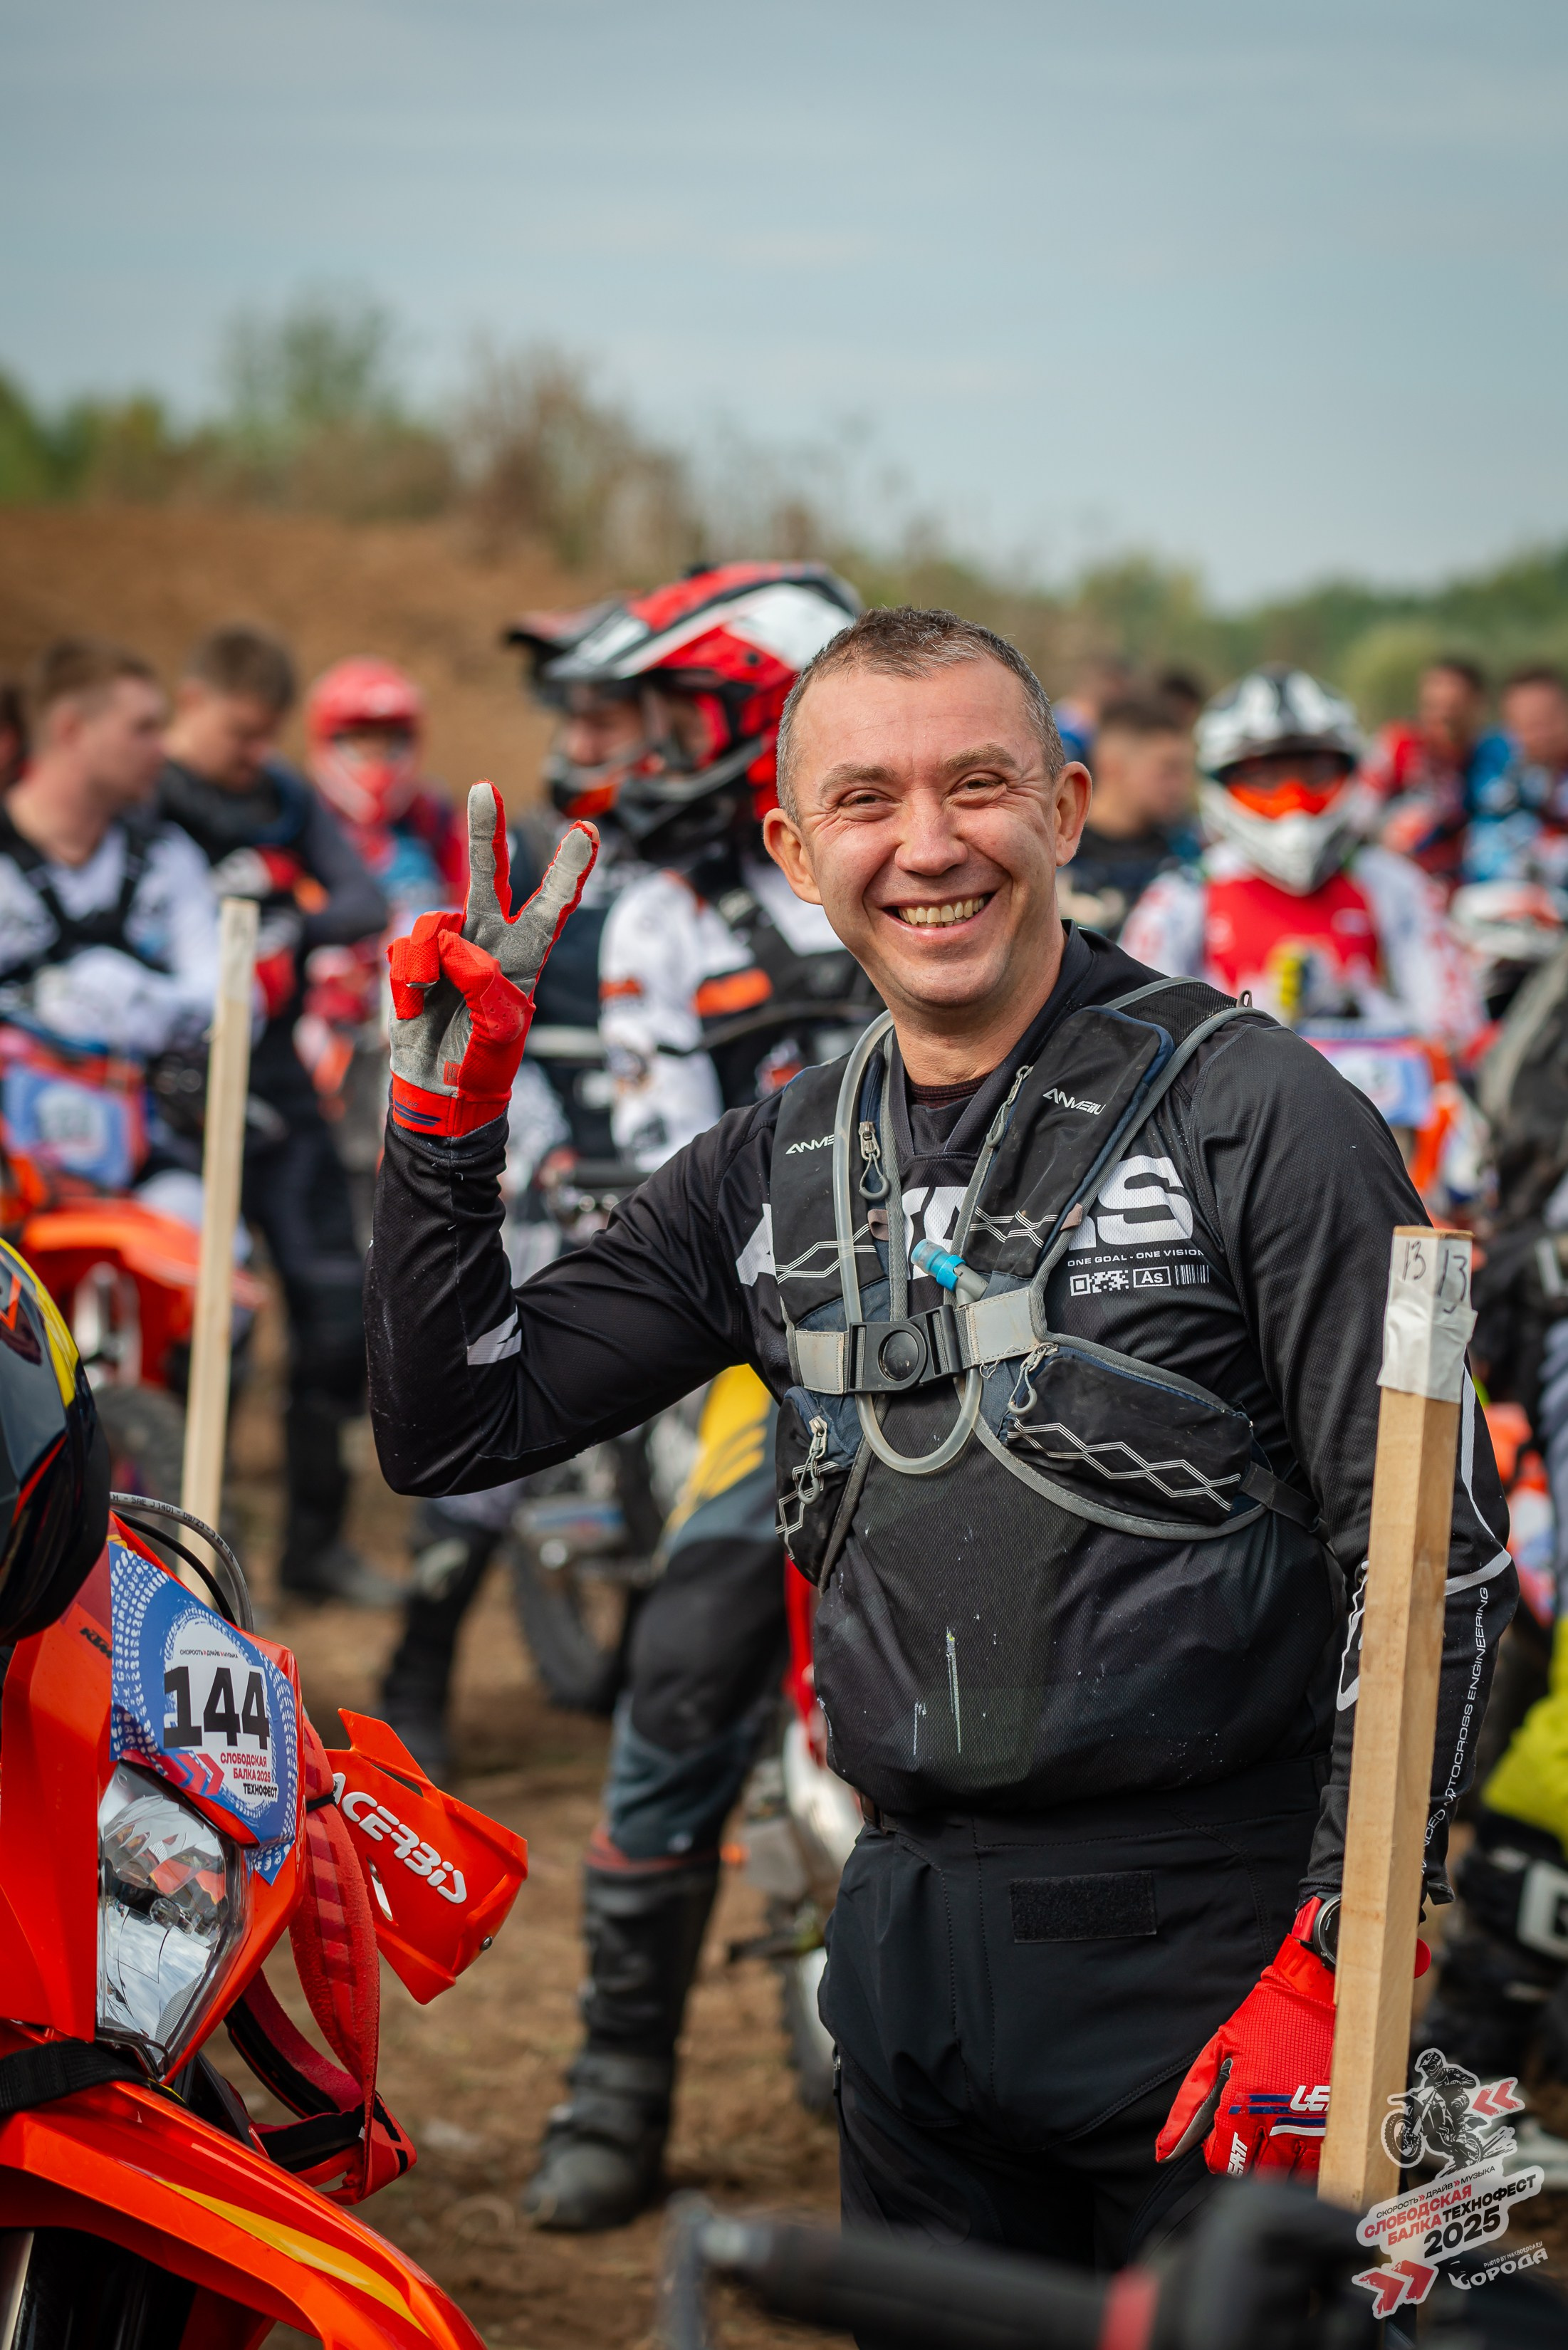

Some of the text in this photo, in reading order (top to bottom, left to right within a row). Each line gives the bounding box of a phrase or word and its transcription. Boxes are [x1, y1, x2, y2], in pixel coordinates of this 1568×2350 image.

[785, 1134, 835, 1155] ANME
[1068, 1258, 1092, 1266] ONE
[1094, 1254, 1127, 1263] GOAL
[1136, 1250, 1161, 1259] ONE
[1163, 1249, 1204, 1258] VISION
[1402, 1240, 1426, 1281] 13
[1141, 1271, 1164, 1284] As
[1437, 1248, 1468, 1315] 13
[132, 1496, 147, 1506] SAE
[80, 1628, 112, 1659] KTM
[1468, 1587, 1489, 1701] ENGINEERING
[164, 1666, 270, 1750] 144
[220, 1753, 267, 1767] СЛОБОДСКАЯ
[1443, 1703, 1474, 1806] MOTOCROSS
[233, 1768, 271, 1782] БАЛКА 2025
[243, 1783, 278, 1798] ТЕХНОФЕСТ
[1227, 2131, 1248, 2179] EATT
